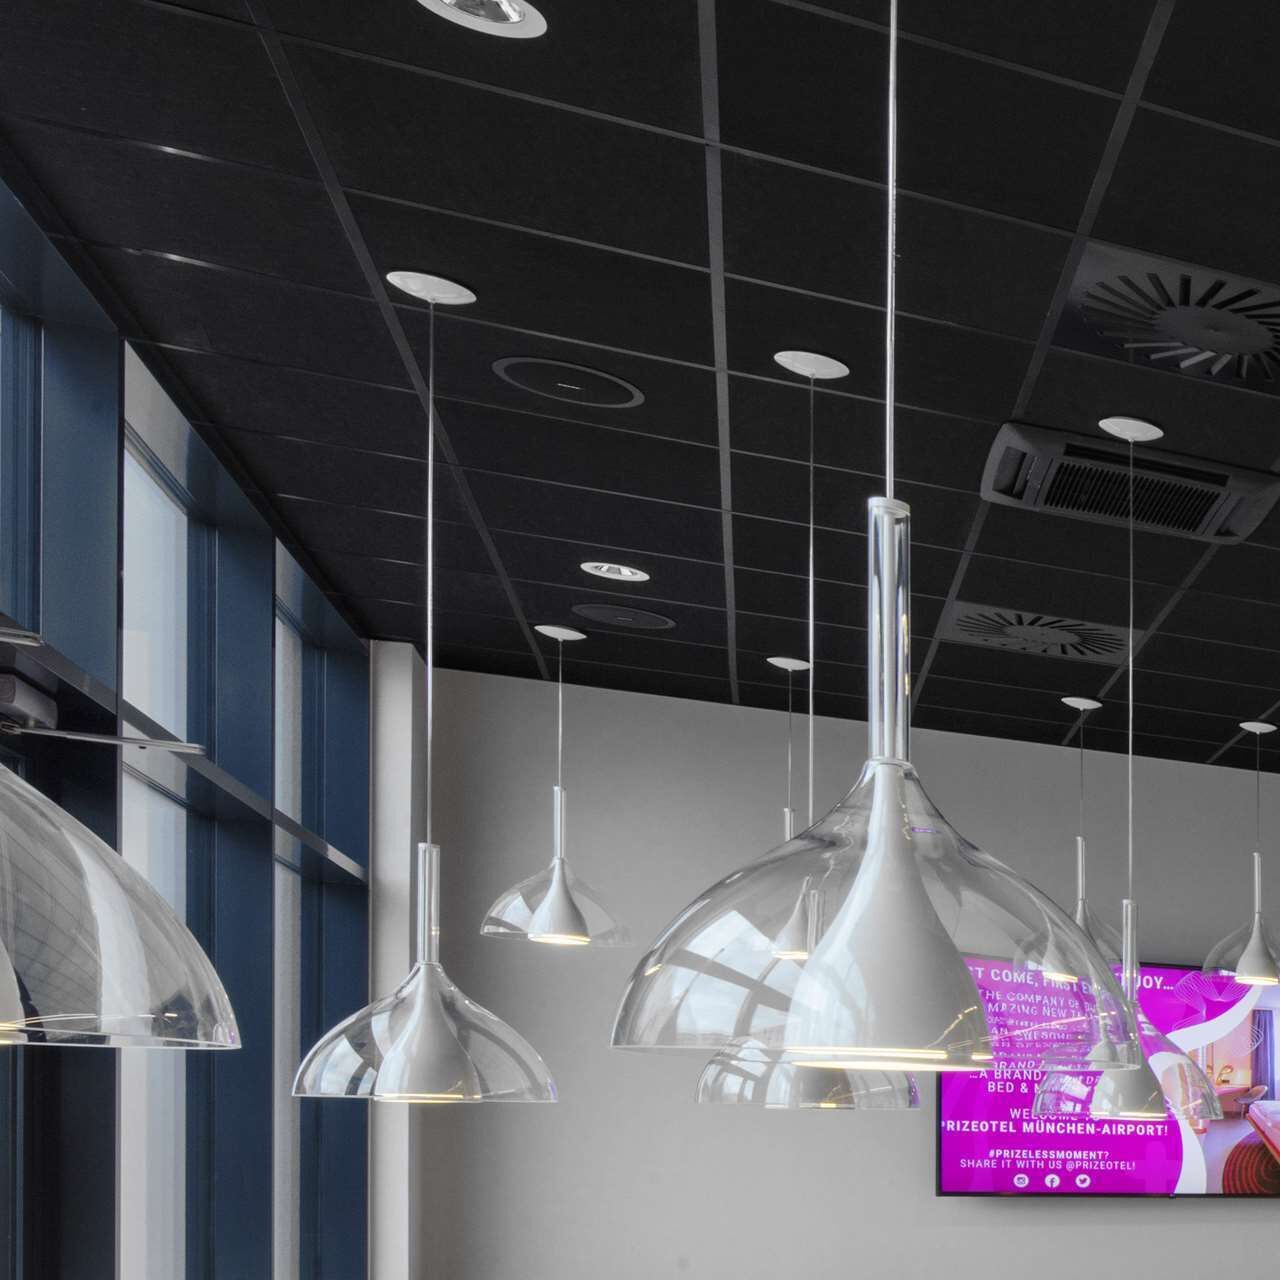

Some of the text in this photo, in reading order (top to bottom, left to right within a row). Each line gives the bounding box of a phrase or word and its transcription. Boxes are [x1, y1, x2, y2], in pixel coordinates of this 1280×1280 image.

[987, 1081, 1014, 1093] BED
[1020, 1082, 1028, 1093] &
[1022, 1119, 1168, 1136] MÜNCHEN-AIRPORT!
[989, 1149, 1110, 1160] #PRIZELESSMOMENT?
[960, 1159, 1136, 1172] SHARE IT WITH US @PRIZEOTEL!
